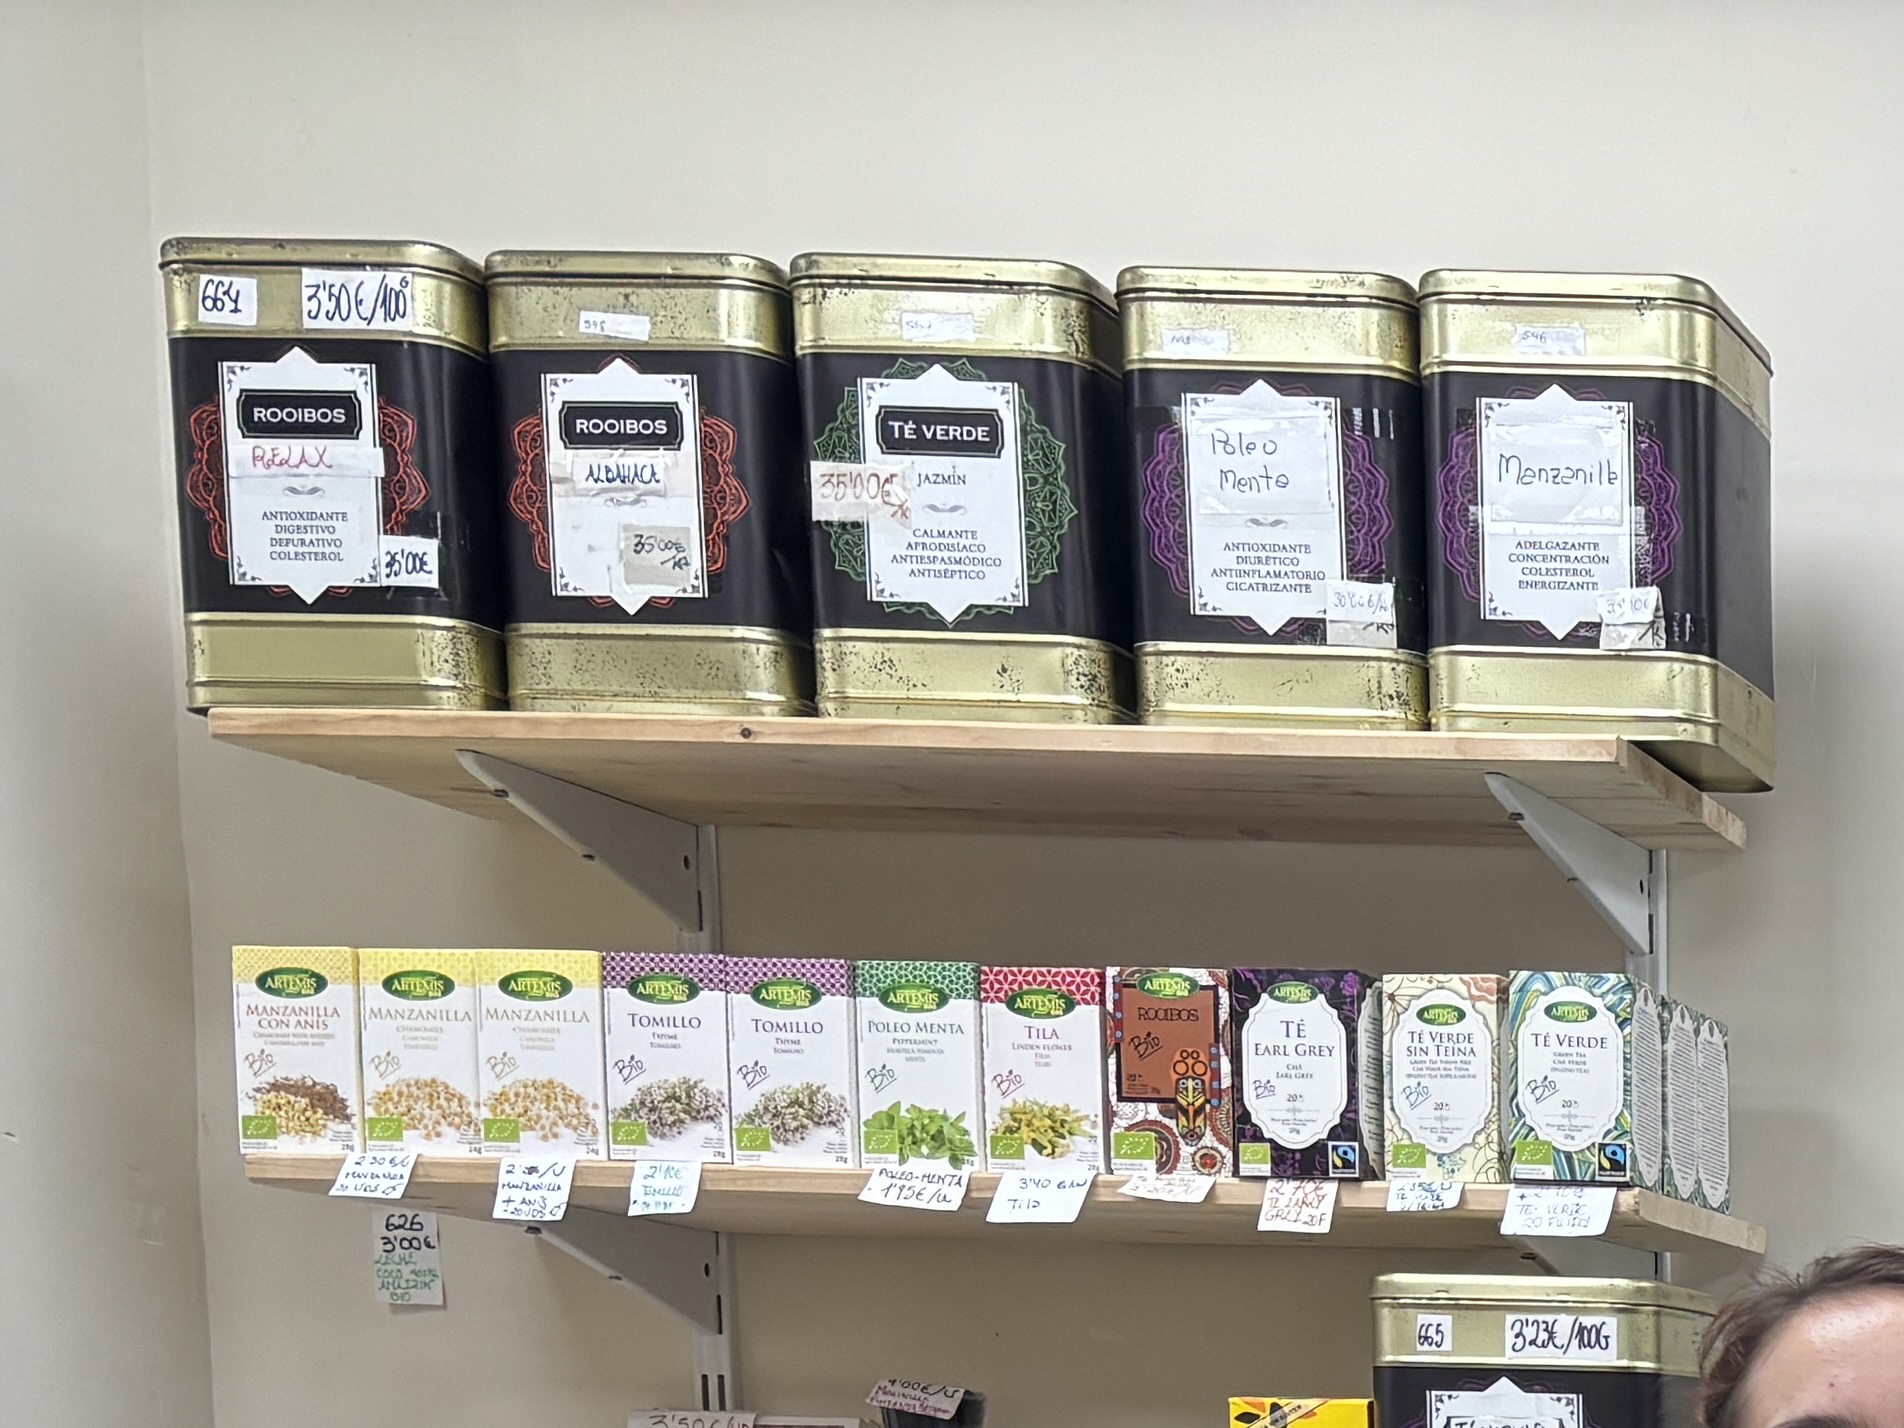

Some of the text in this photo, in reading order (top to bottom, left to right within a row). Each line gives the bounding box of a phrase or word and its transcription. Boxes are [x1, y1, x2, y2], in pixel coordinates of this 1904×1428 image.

[252, 406, 346, 425] ROOIBOS
[576, 418, 667, 437] ROOIBOS
[887, 418, 990, 442] TÉ VERDE
[1210, 429, 1278, 457] Poleo
[917, 466, 966, 486] JAZMÍN
[261, 511, 348, 523] ANTIOXIDANTE
[274, 524, 336, 535] DIGESTIVO
[913, 528, 978, 540] CALMANTE
[270, 537, 343, 549] DEPURATIVO
[906, 540, 986, 553] AFRODISÍACO
[1223, 542, 1311, 554] ANTIOXIDANTE
[1515, 541, 1600, 551] ADELGAZANTE
[269, 550, 344, 563] COLESTEROL
[891, 553, 1002, 567] ANTIESPASMÓDICO
[1235, 553, 1300, 567] DIURÉTICO
[1508, 553, 1609, 565] CONCENTRACIÓN
[908, 566, 986, 580] ANTISÉPTICO
[1211, 567, 1326, 581] ANTIINFLAMATORIO
[1522, 567, 1594, 577] COLESTEROL
[1226, 581, 1312, 594] CICATRIZANTE
[1518, 580, 1598, 591] ENERGIZANTE
[246, 1004, 341, 1019] MANZANILLA
[369, 1006, 472, 1023] MANZANILLA
[485, 1007, 590, 1023] MANZANILLA
[1138, 1007, 1199, 1022] ROOIBOS
[258, 1017, 329, 1031] CON ANIS
[627, 1013, 701, 1029] TOMILLO
[751, 1018, 824, 1035] TOMILLO
[867, 1019, 965, 1036] POLEO MENTA
[1024, 1025, 1059, 1041] TILA
[1280, 1019, 1307, 1039] TÉ
[1407, 1028, 1475, 1045] TÉ VERDE
[1532, 1031, 1608, 1049] TÉ VERDE
[1254, 1043, 1335, 1058] EARL GREY
[1406, 1044, 1477, 1058] SIN TEINA
[385, 1214, 423, 1234] 626
[1418, 1324, 1444, 1347] 665
